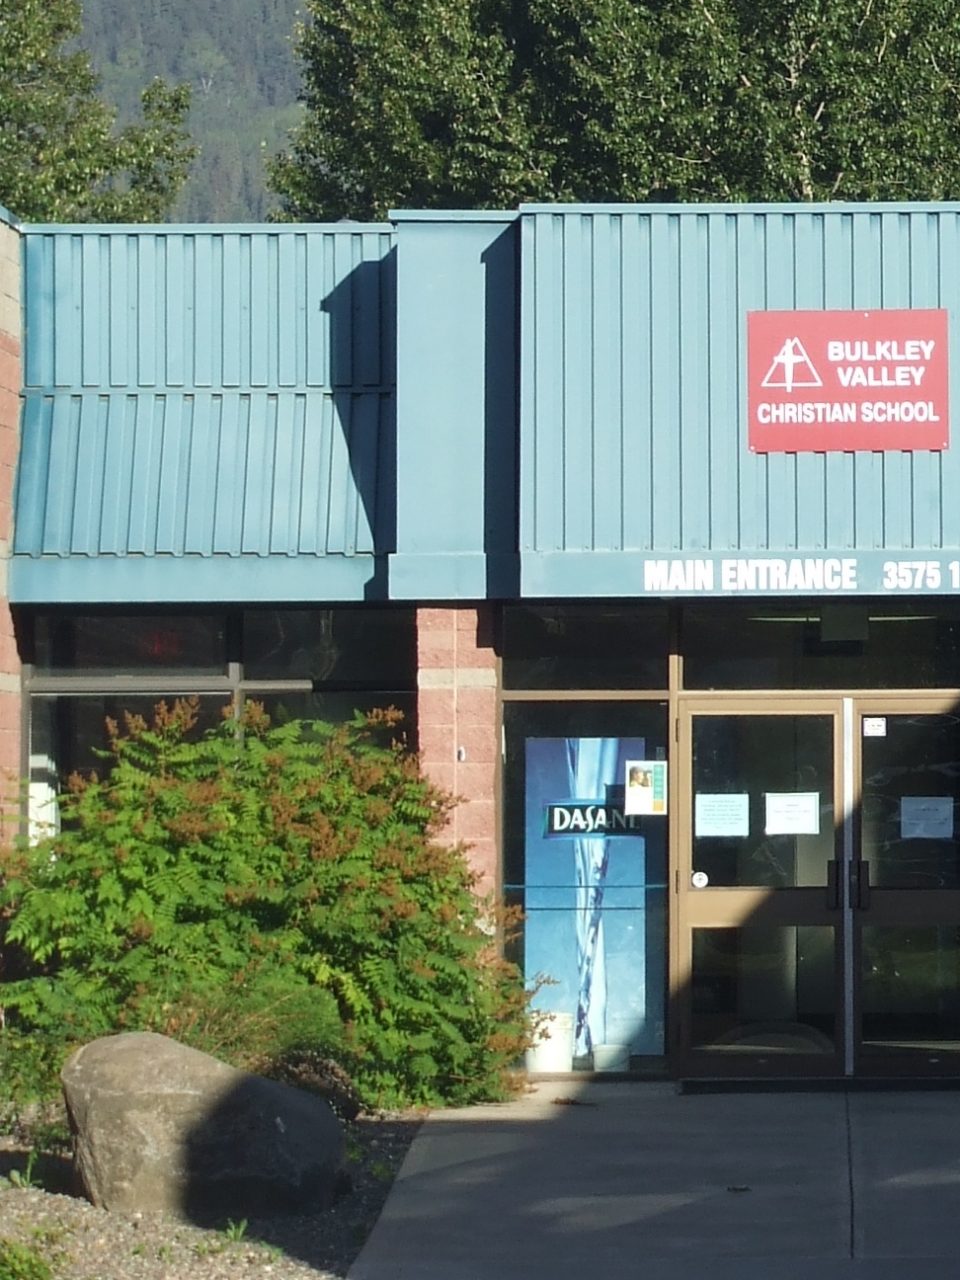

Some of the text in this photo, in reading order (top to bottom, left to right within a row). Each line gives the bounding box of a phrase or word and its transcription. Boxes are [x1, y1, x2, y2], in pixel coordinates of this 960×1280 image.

[827, 340, 935, 361] BULKLEY
[837, 366, 925, 387] VALLEY
[757, 401, 940, 424] CHRISTIAN SCHOOL
[643, 560, 714, 591] MAIN
[721, 558, 857, 590] ENTRANCE
[883, 561, 941, 589] 3575
